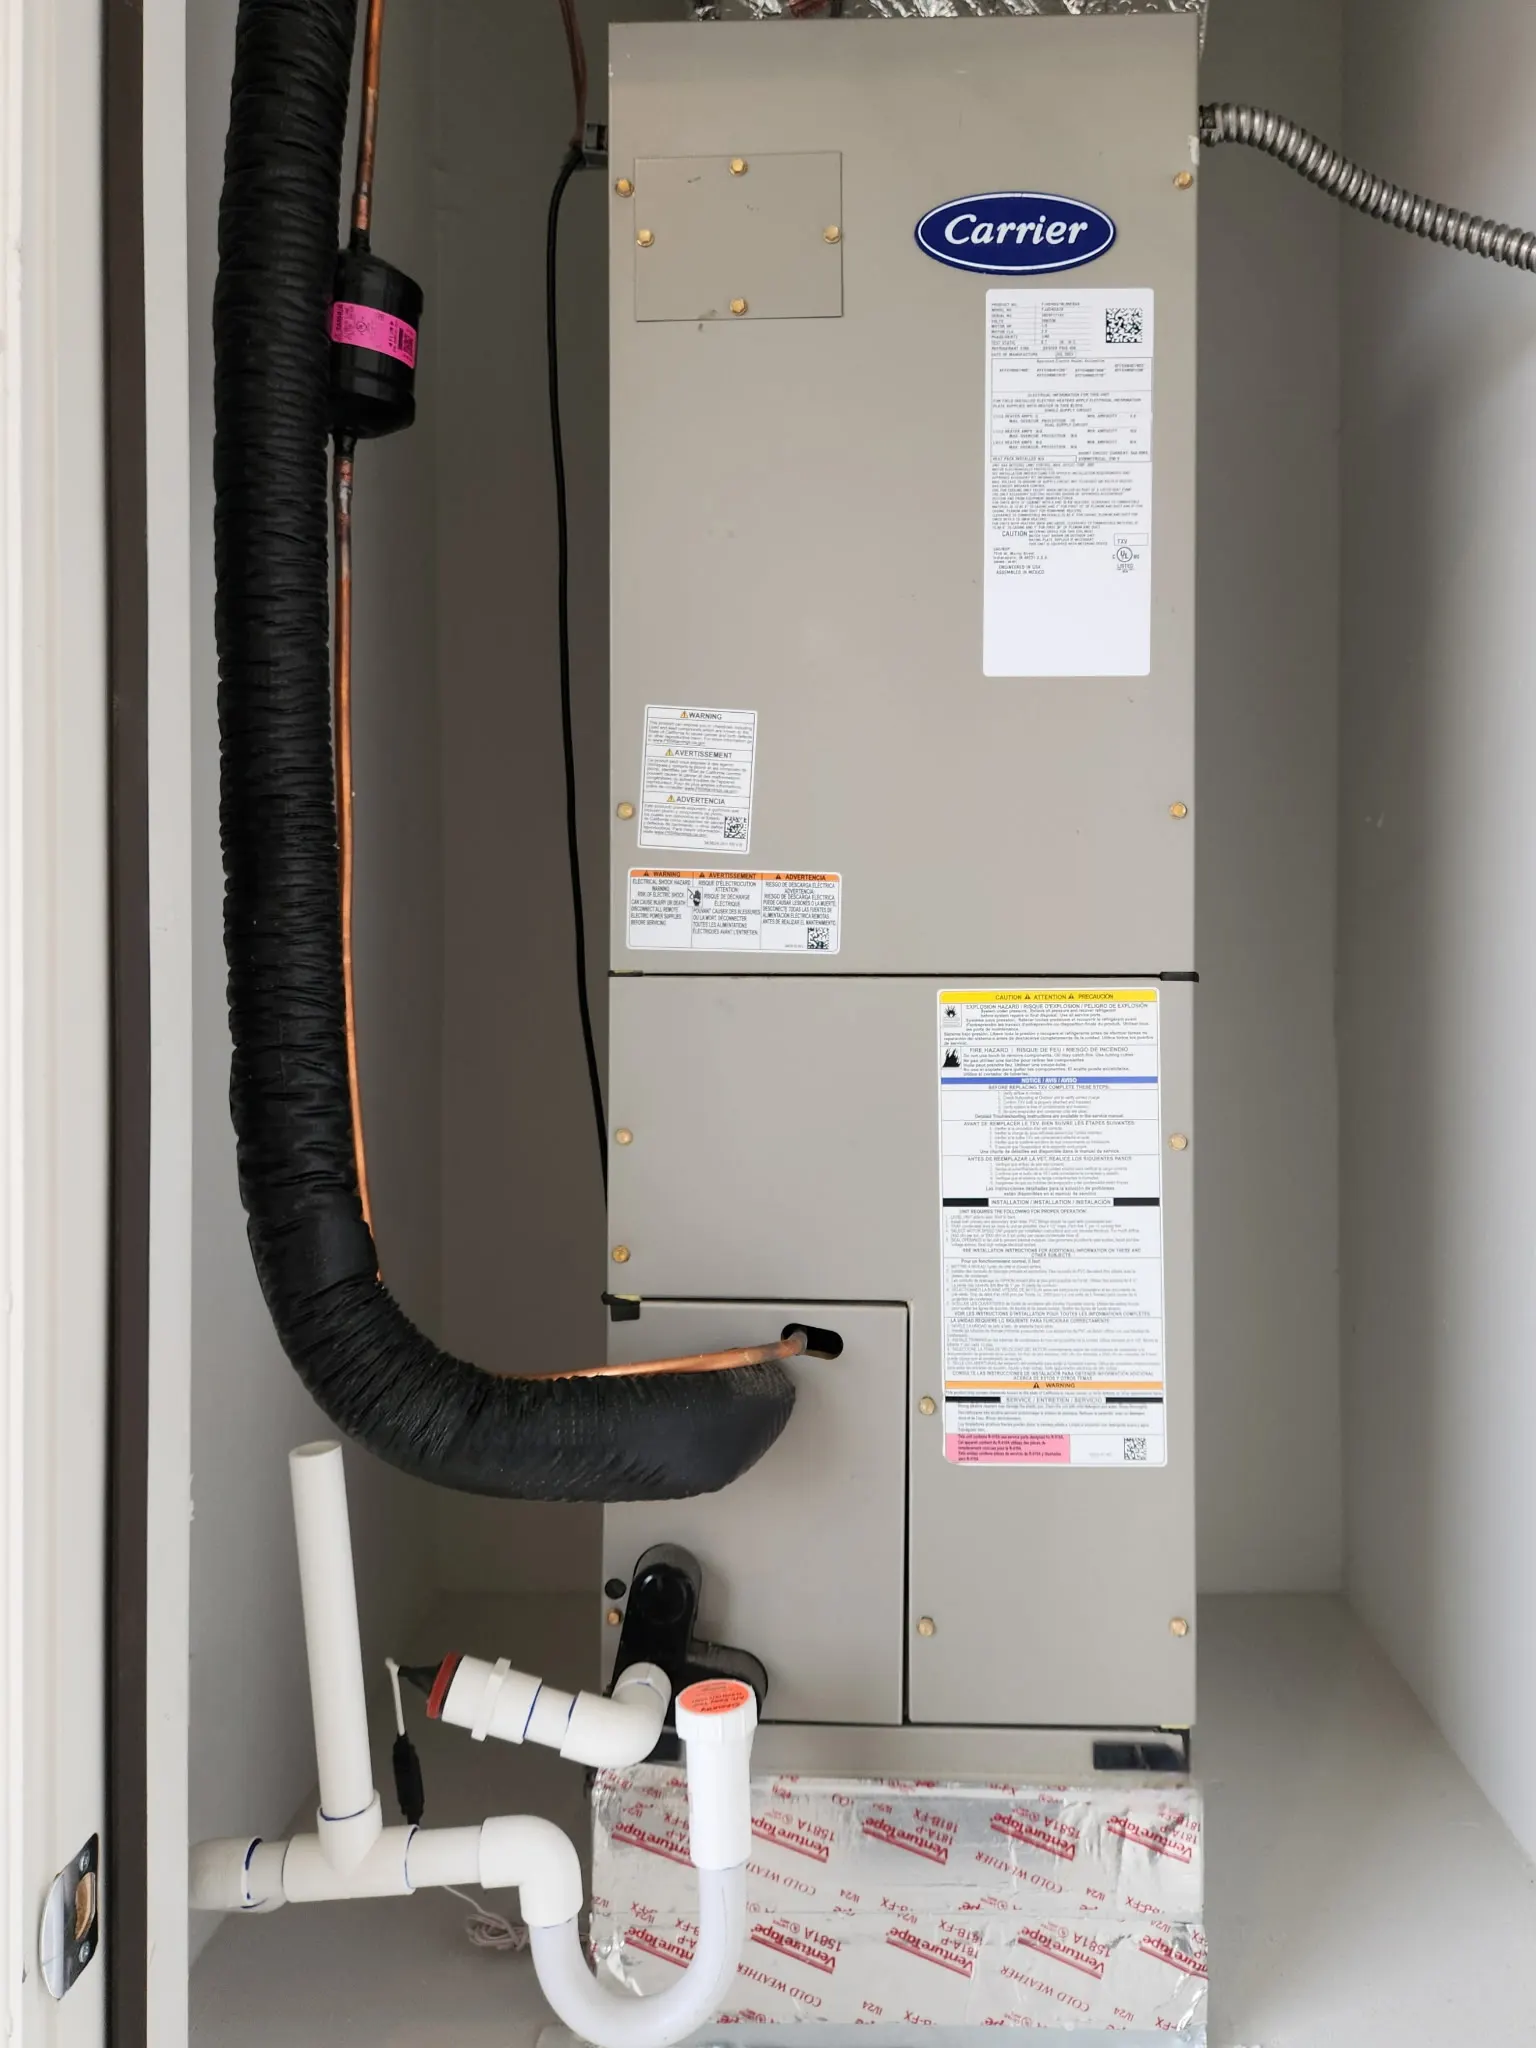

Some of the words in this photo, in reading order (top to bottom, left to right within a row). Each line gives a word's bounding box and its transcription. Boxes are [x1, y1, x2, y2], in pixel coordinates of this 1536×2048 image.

[944, 213, 1089, 245] Carrier
[688, 712, 722, 720] WARNING
[674, 750, 732, 758] AVERTISSEMENT
[676, 796, 725, 804] ADVERTENCIA
[798, 1818, 836, 1842] 1581A
[1043, 1816, 1082, 1840] 1581A
[976, 1850, 1028, 1882] WEATHER
[783, 1876, 816, 1897] COLD
[1030, 1873, 1063, 1894] COLD
[753, 1924, 836, 1968] VentureTape
[804, 1926, 843, 1953] 1581A
[889, 1927, 974, 1972] VentureTape
[1021, 1926, 1105, 1974] VentureTape
[1072, 1932, 1111, 1958] 1581A
[1000, 1965, 1054, 1998] WEATHER
[789, 1986, 822, 2008] COLD
[1057, 1992, 1090, 2014] COLD
